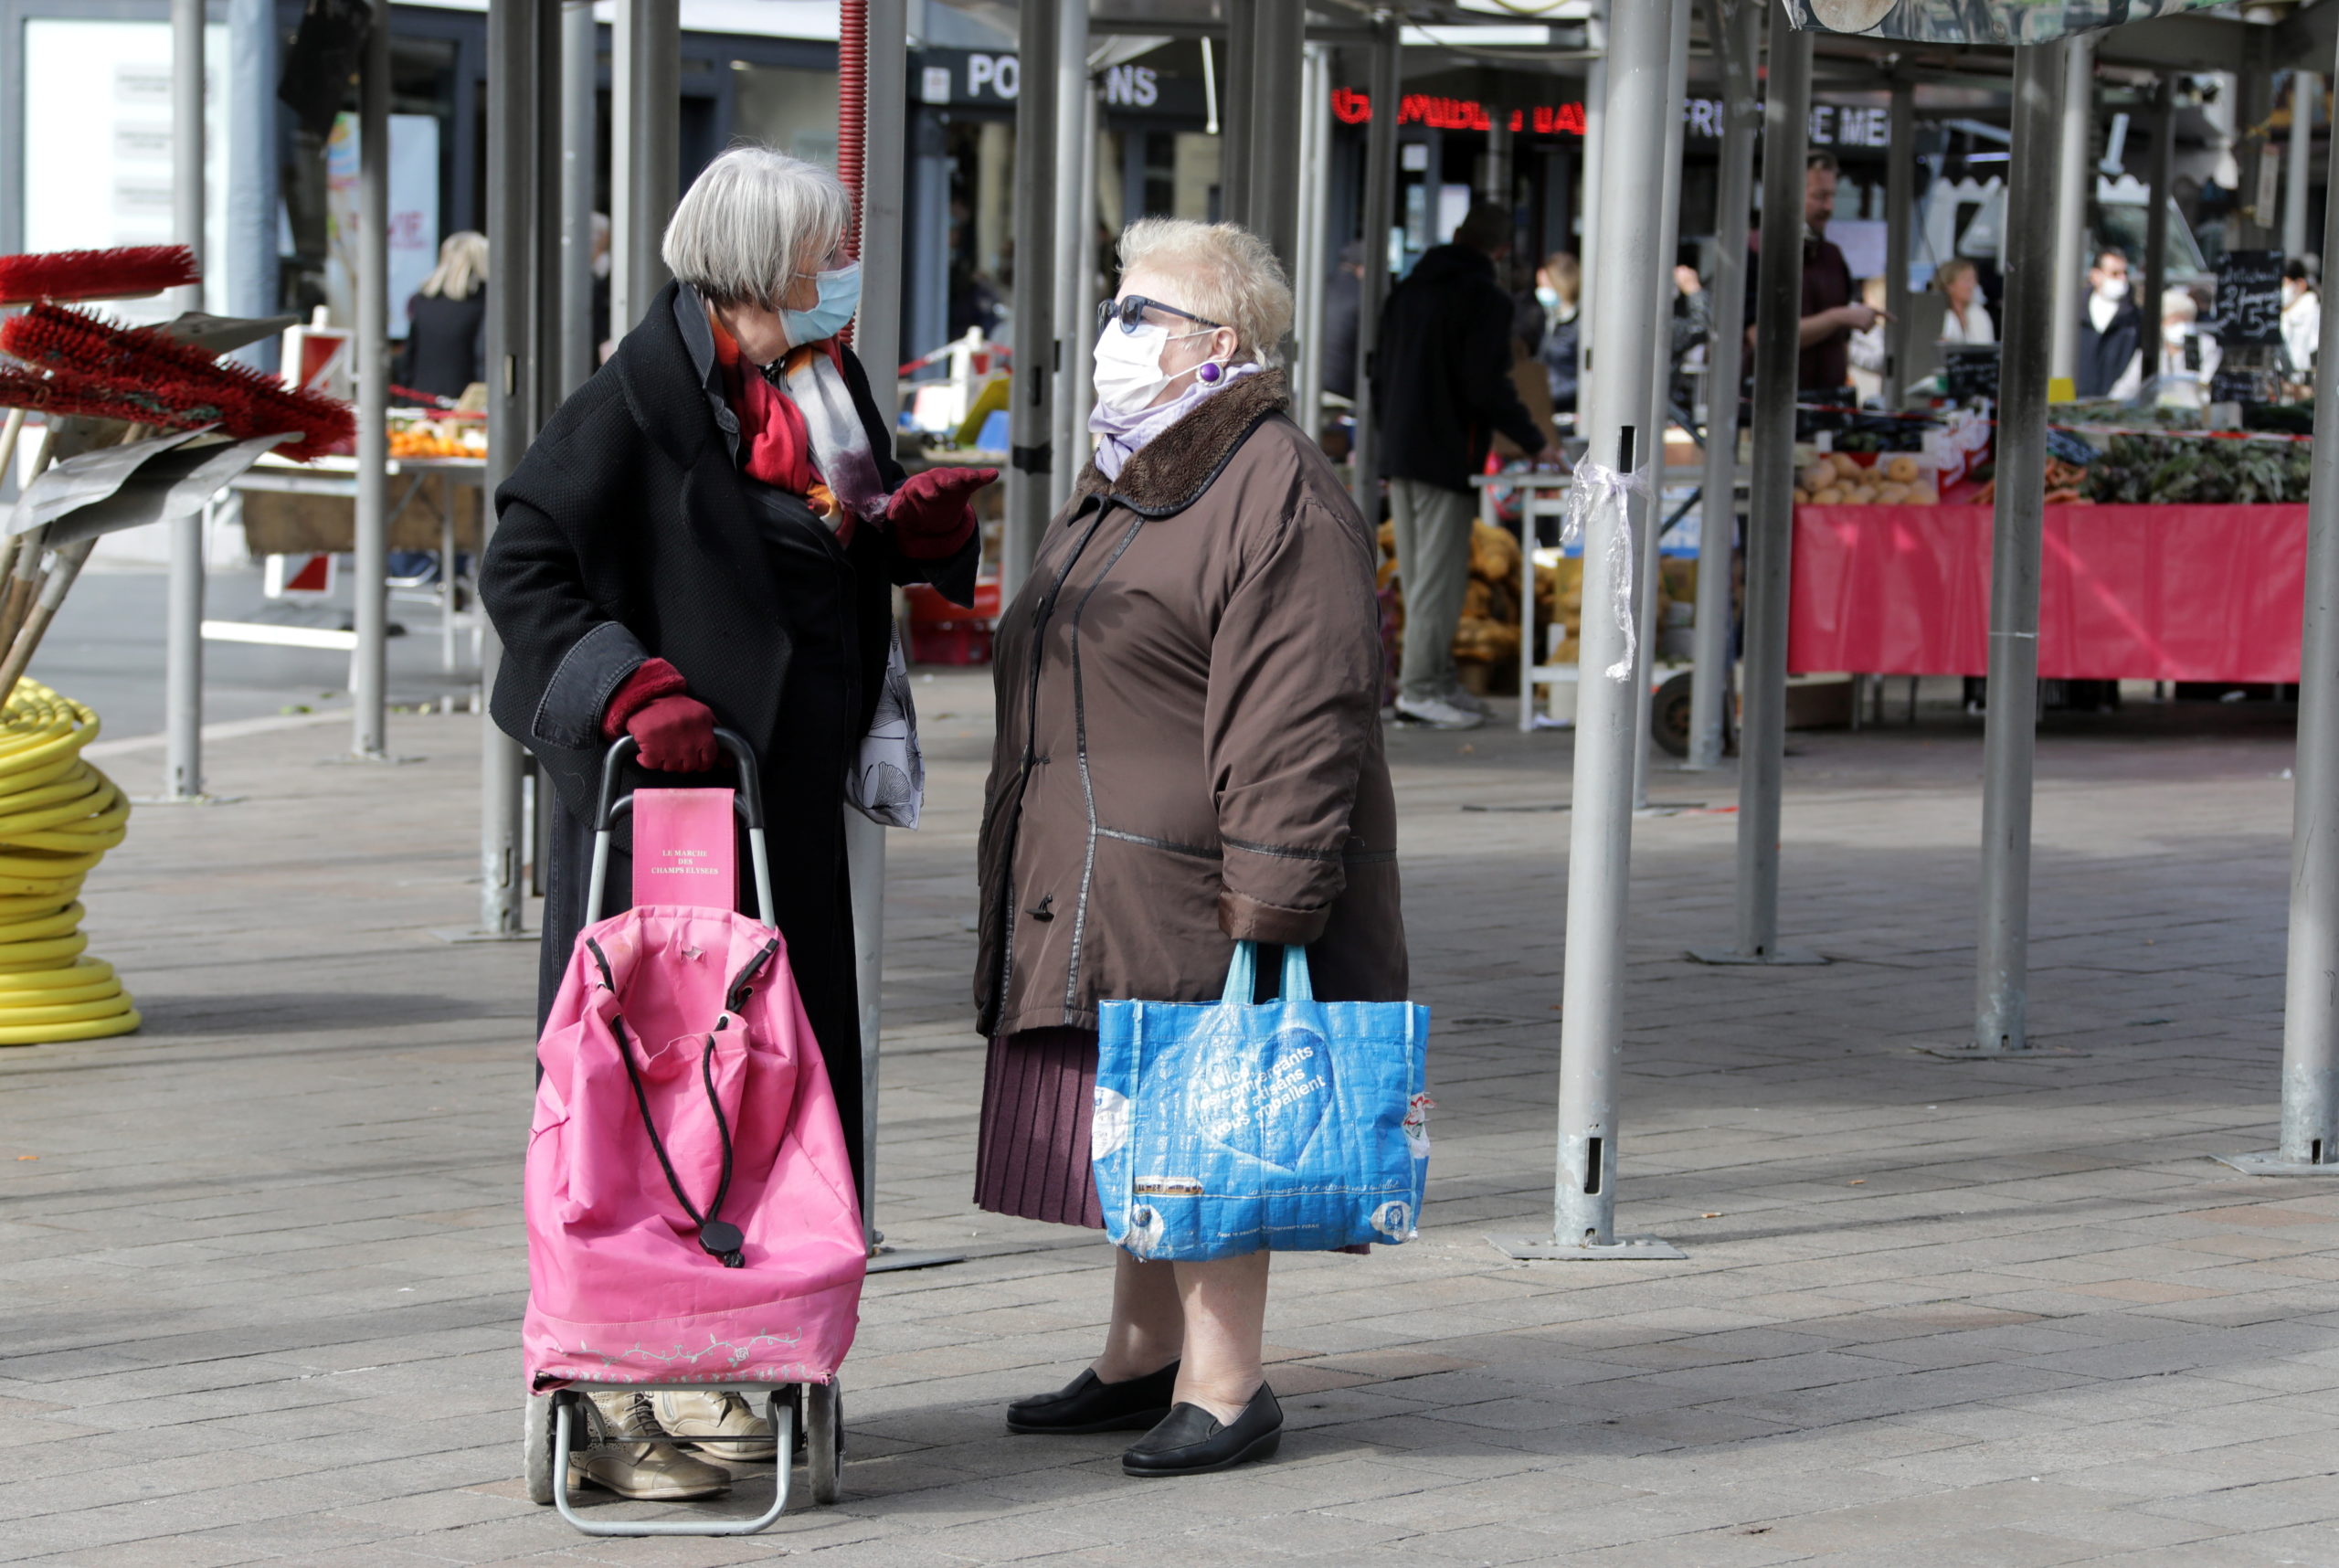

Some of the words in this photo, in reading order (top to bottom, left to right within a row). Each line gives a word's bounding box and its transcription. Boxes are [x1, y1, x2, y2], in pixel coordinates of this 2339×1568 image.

[1839, 108, 1892, 146] ME
[1232, 1097, 1249, 1113] et
[1212, 1113, 1250, 1137] vous
